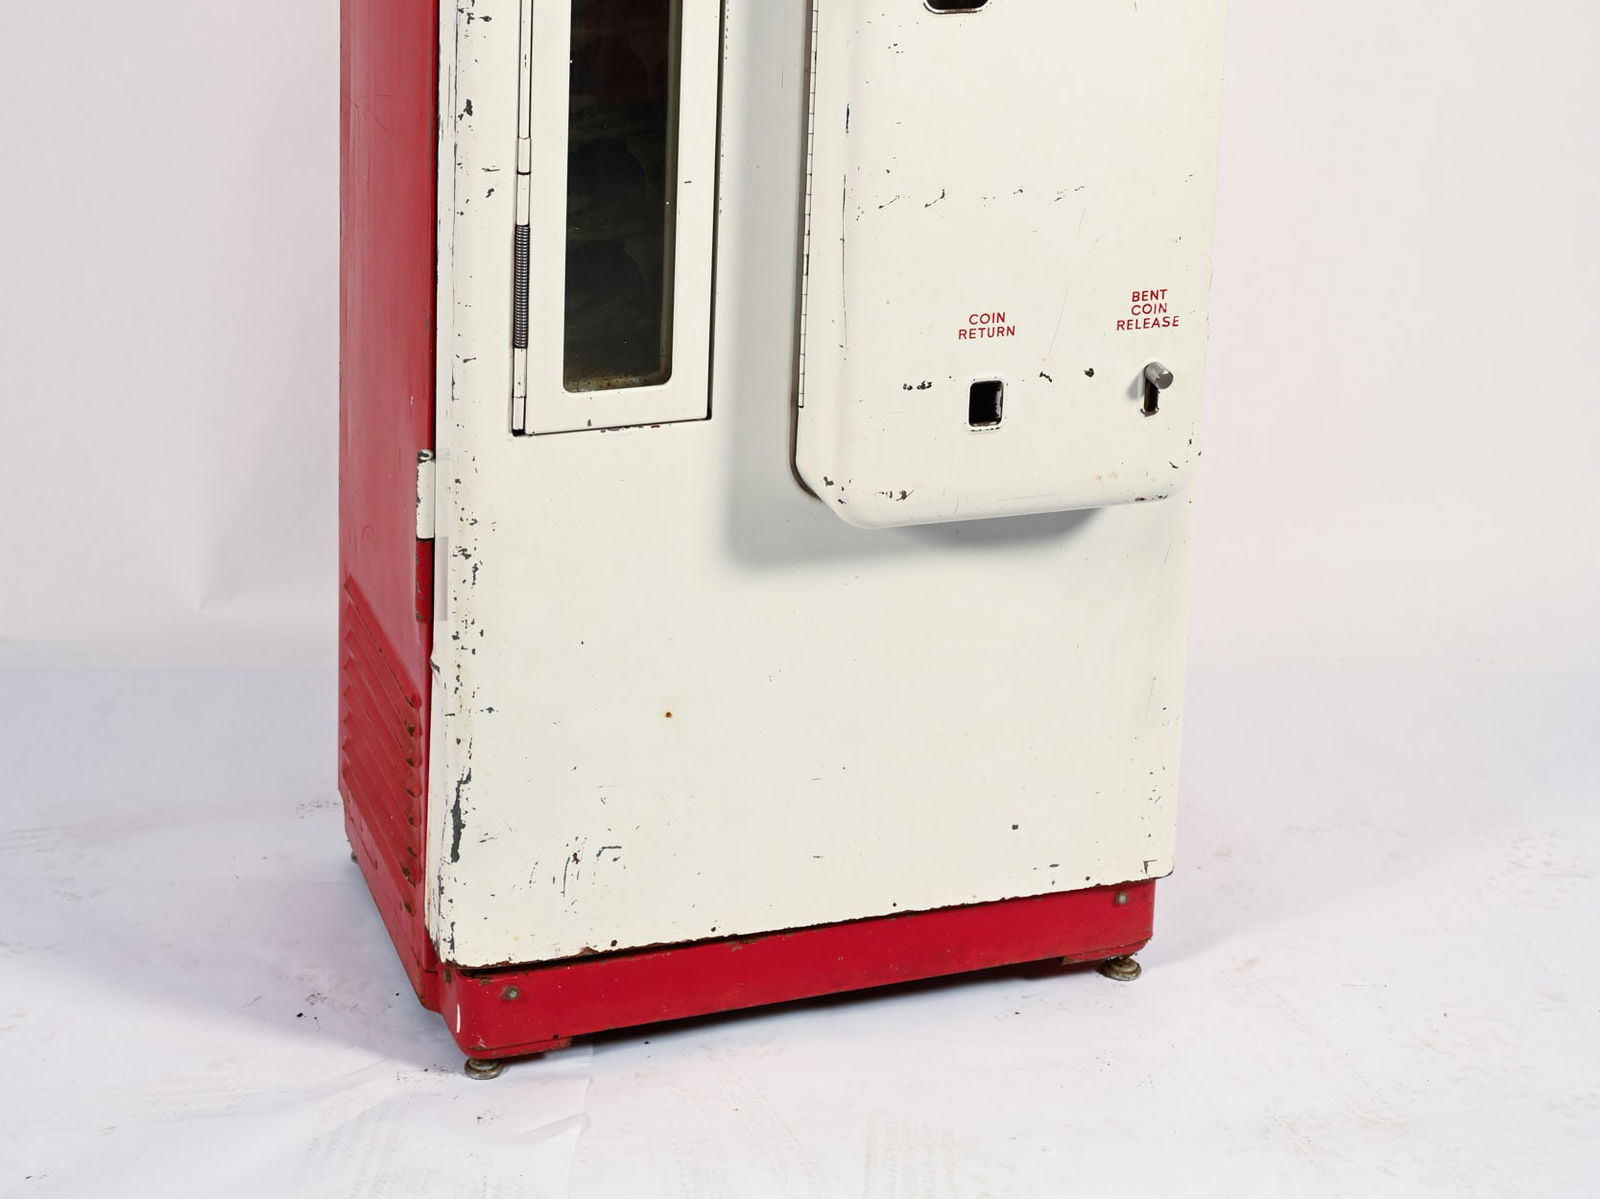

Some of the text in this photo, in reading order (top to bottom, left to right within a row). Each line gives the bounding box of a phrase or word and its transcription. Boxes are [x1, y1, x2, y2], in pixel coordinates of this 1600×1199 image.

[1131, 289, 1168, 302] BENT
[1130, 303, 1168, 316] COIN
[968, 311, 1006, 325] COIN
[1116, 315, 1180, 331] RELEASE
[957, 325, 1016, 340] RETURN
